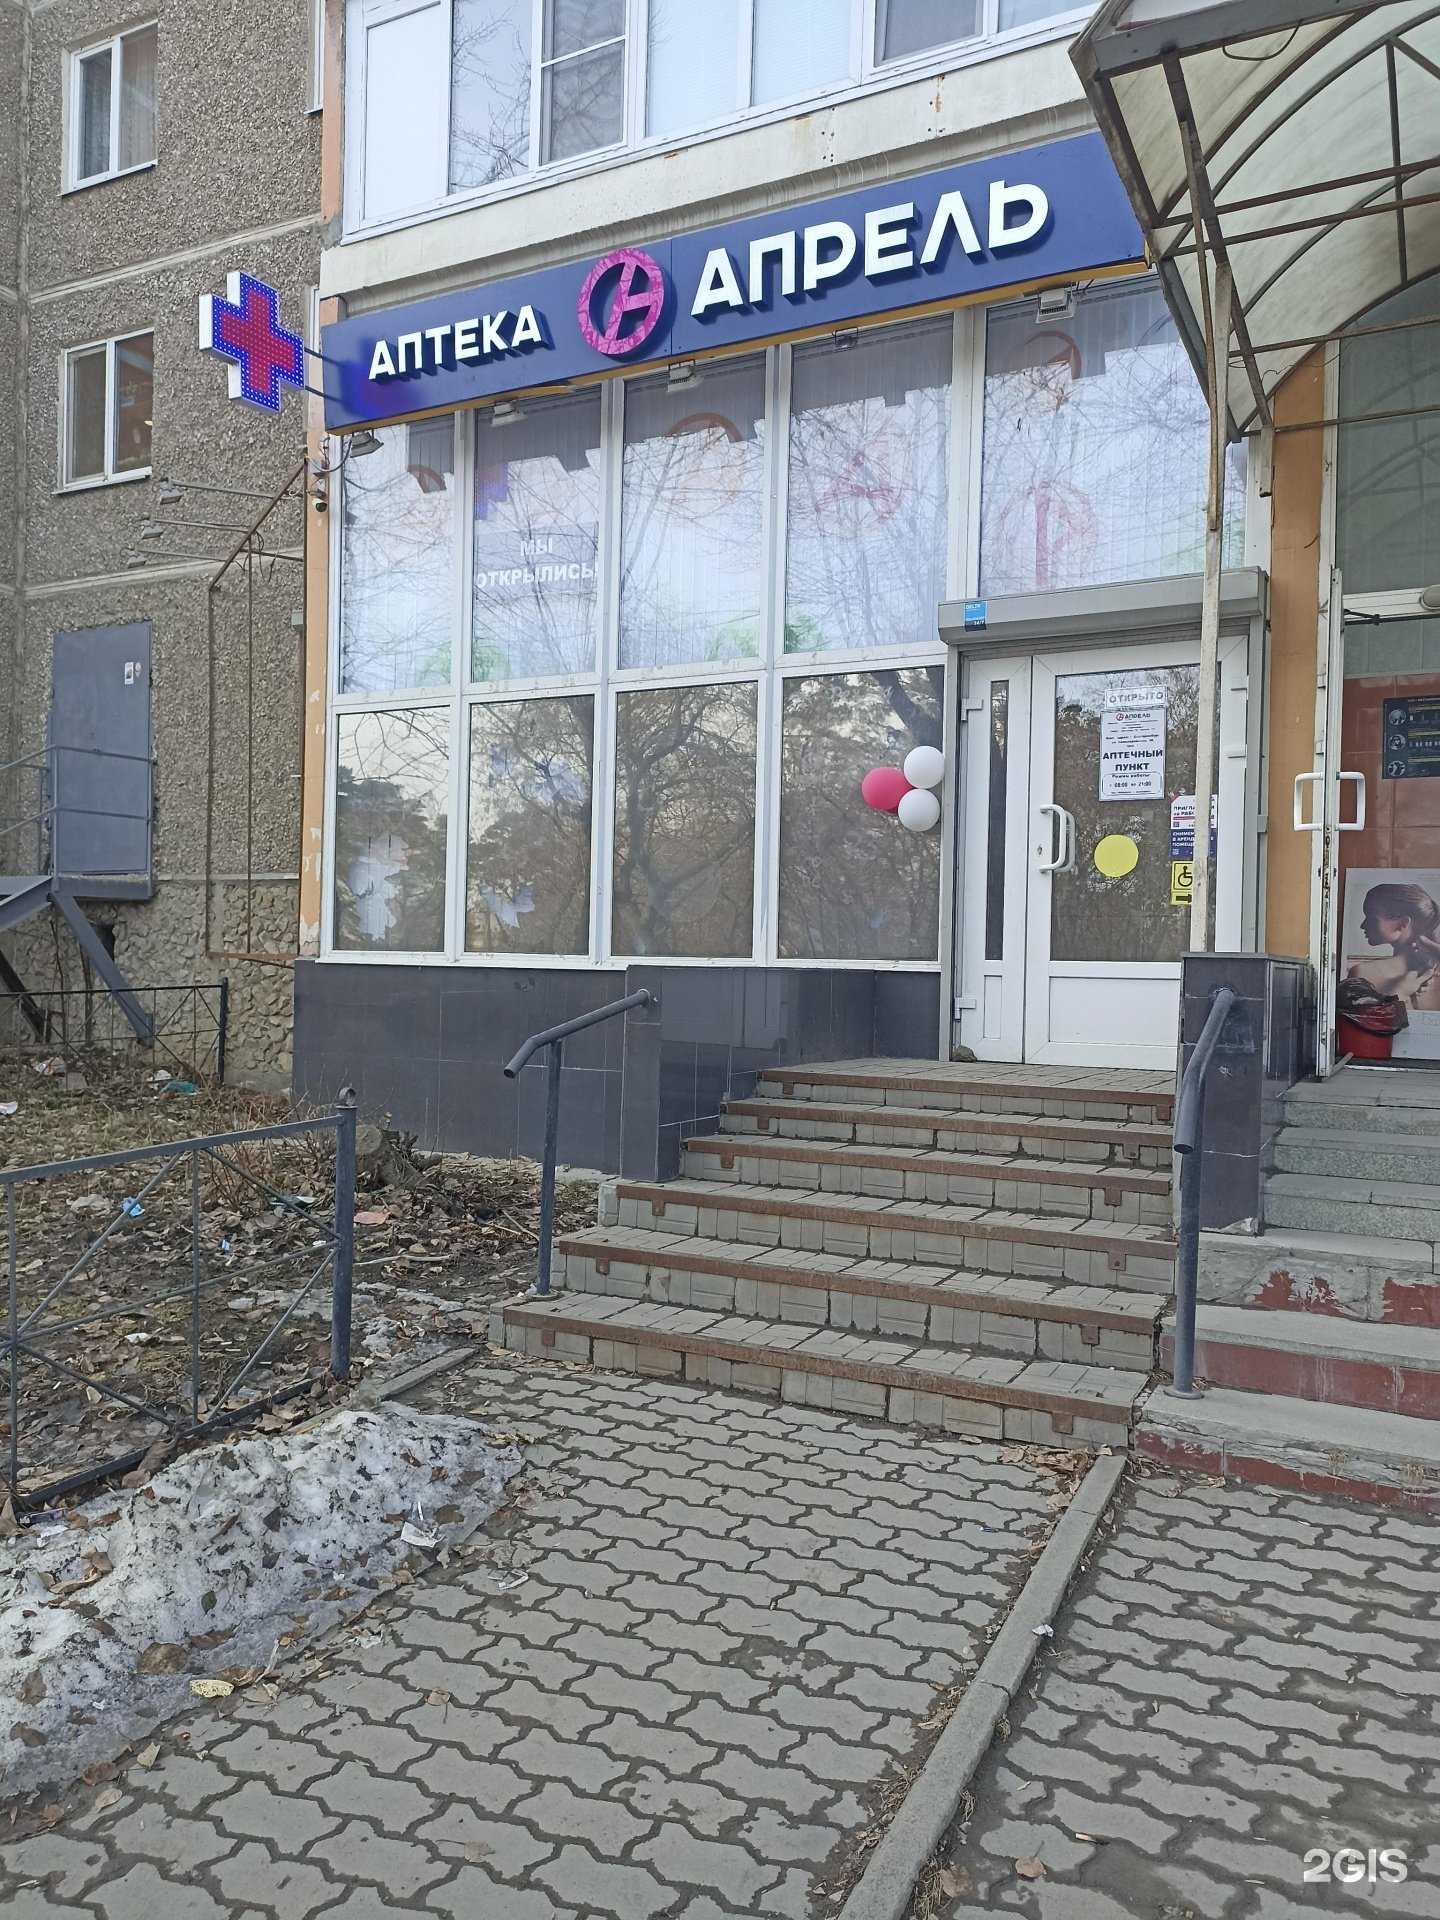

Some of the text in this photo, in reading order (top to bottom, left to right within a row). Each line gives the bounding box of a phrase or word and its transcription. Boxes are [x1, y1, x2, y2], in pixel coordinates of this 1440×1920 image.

[368, 180, 1050, 380] АПТЕКА АПРЕЛЬ
[520, 537, 553, 556] МЫ
[1109, 692, 1163, 703] ОТКРЫТО
[1103, 750, 1163, 759] АПТЕЧНЫЙ
[1115, 763, 1150, 771] ПУНКТ
